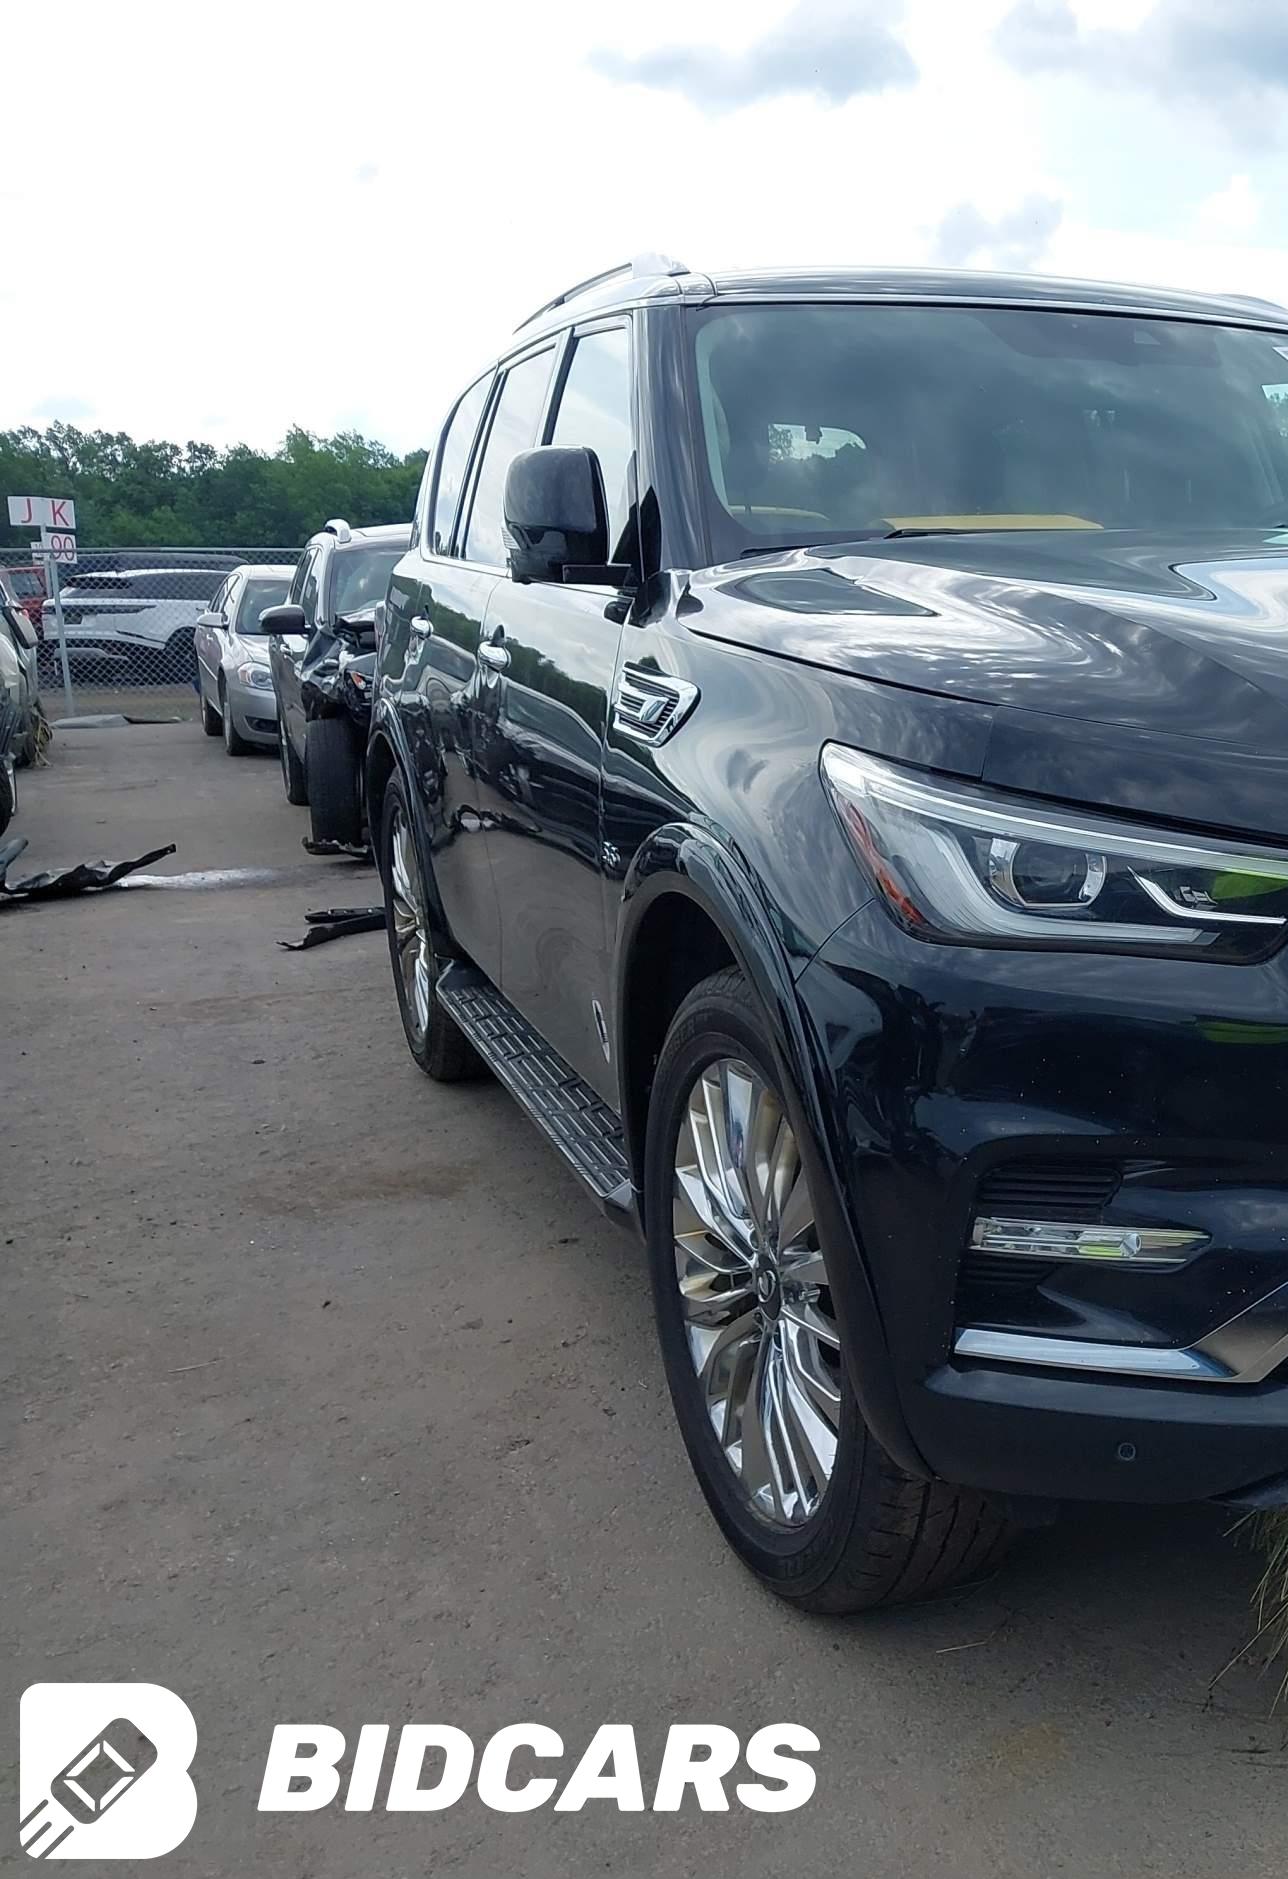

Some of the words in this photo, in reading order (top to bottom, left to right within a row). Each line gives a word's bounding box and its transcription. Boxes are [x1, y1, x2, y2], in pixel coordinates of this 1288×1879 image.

[21, 498, 33, 524] J
[51, 500, 70, 526] K
[51, 535, 75, 561] 90
